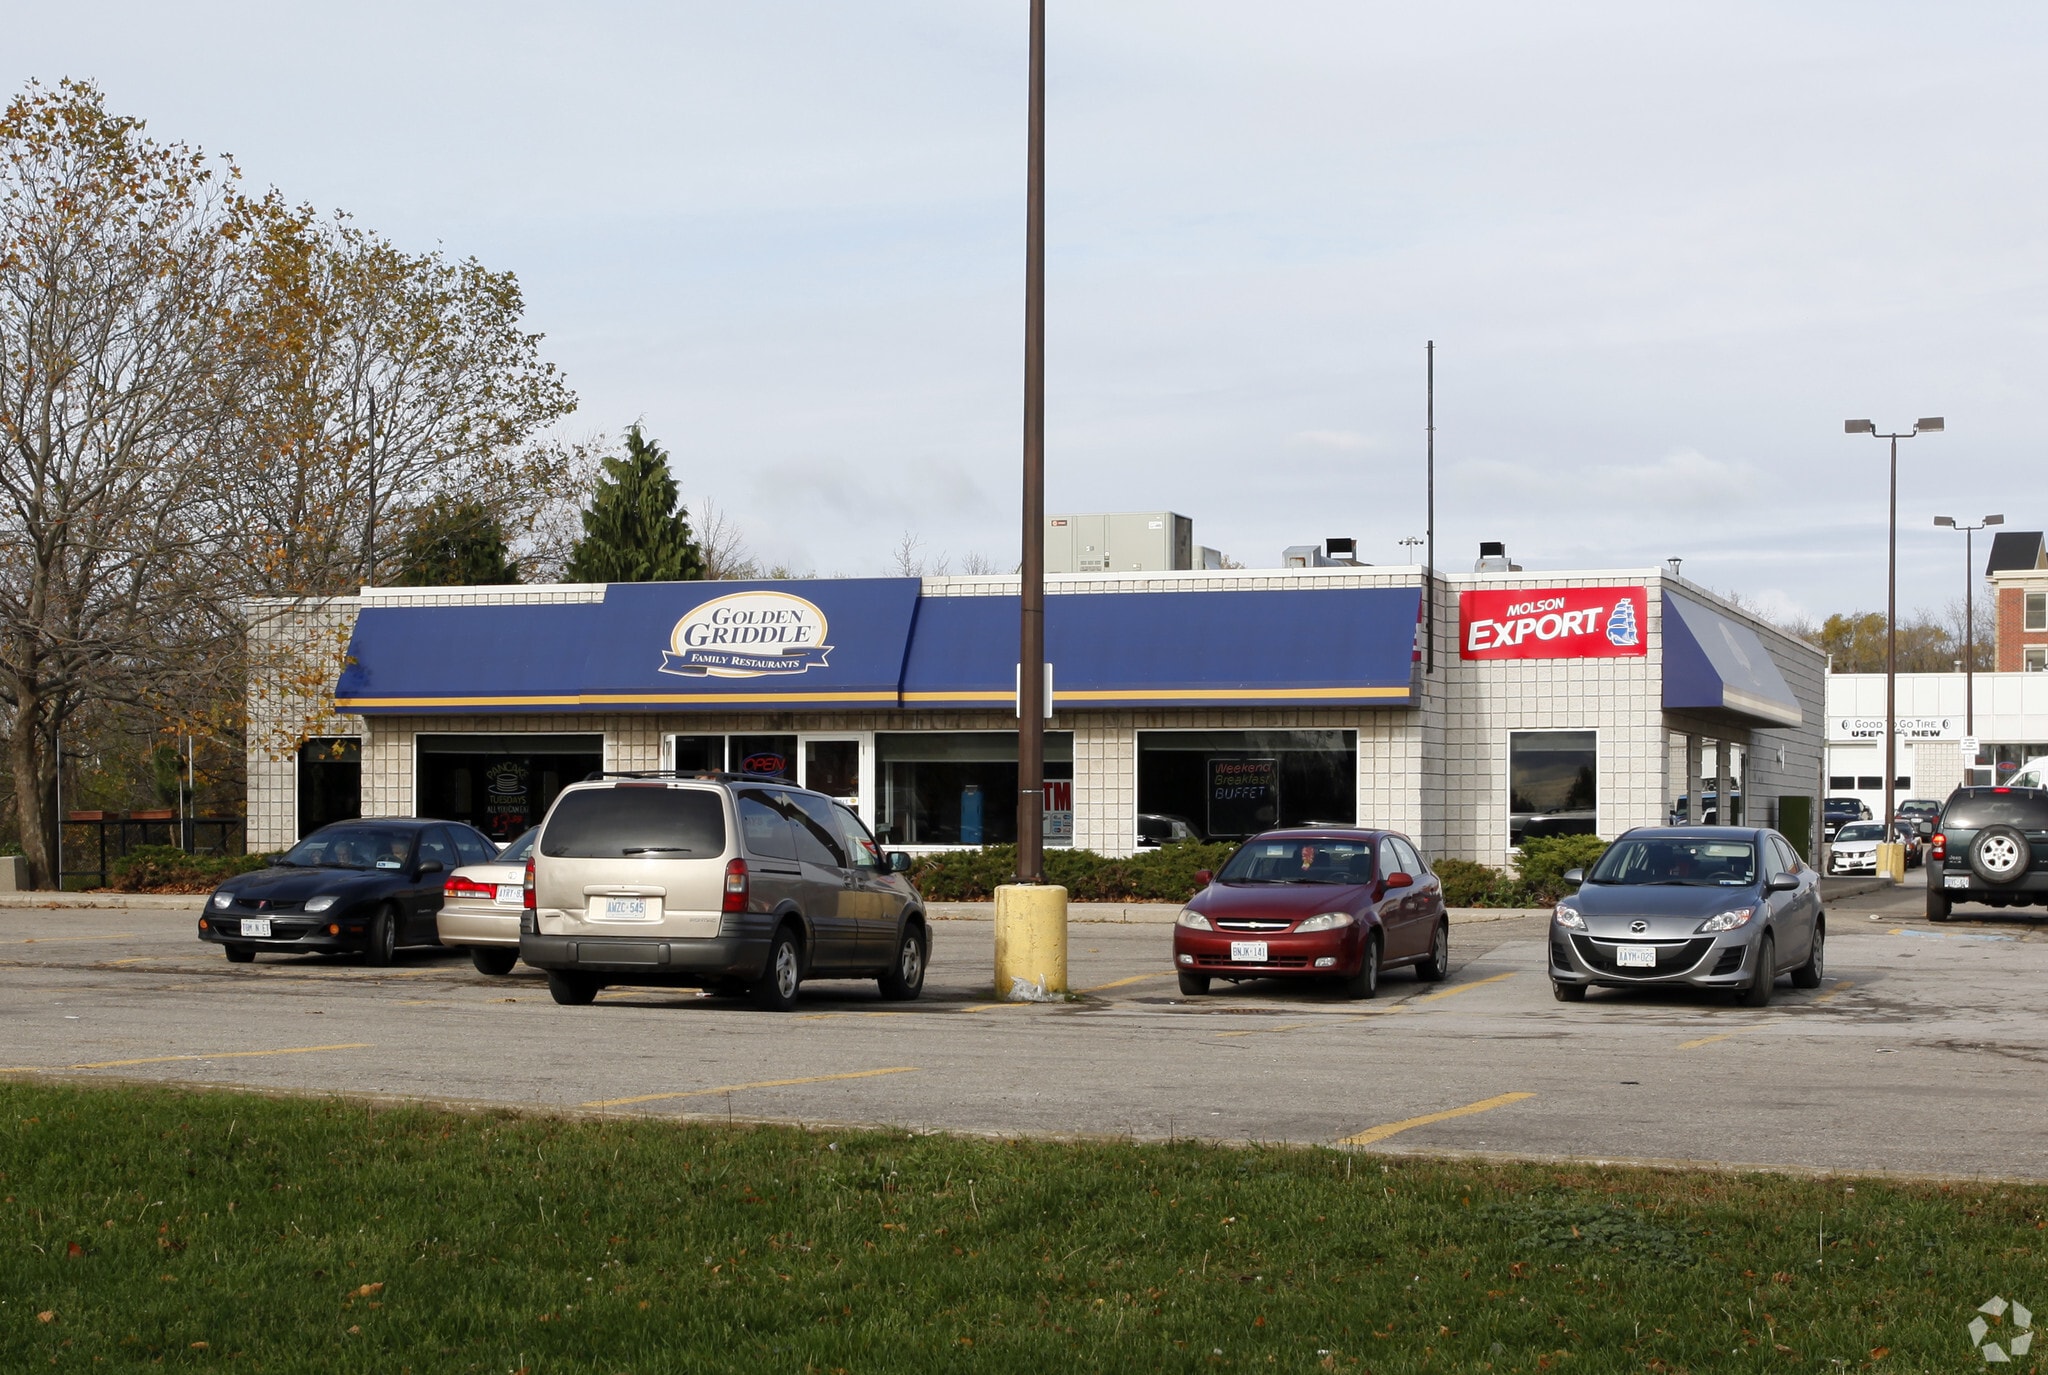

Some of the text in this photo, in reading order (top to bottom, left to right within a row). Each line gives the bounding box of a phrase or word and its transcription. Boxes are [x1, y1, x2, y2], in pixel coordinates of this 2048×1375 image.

[1506, 597, 1565, 617] MOLSON
[712, 608, 805, 625] GOLDEN
[684, 623, 811, 647] GRIDDLE
[1468, 607, 1603, 651] EXPORT
[691, 653, 800, 668] FAMILY RESTAURANTS
[1855, 719, 1883, 729] GOOD
[1899, 719, 1914, 729] GO
[1916, 719, 1937, 729] TIRE
[487, 761, 529, 780] PANCAKE
[743, 757, 786, 771] OPEN
[1215, 763, 1272, 774] Weekend
[1214, 774, 1271, 786] Breakfast
[489, 795, 527, 804] TUESDAYS
[1043, 782, 1071, 811] TM
[1215, 787, 1265, 799] BUFFET
